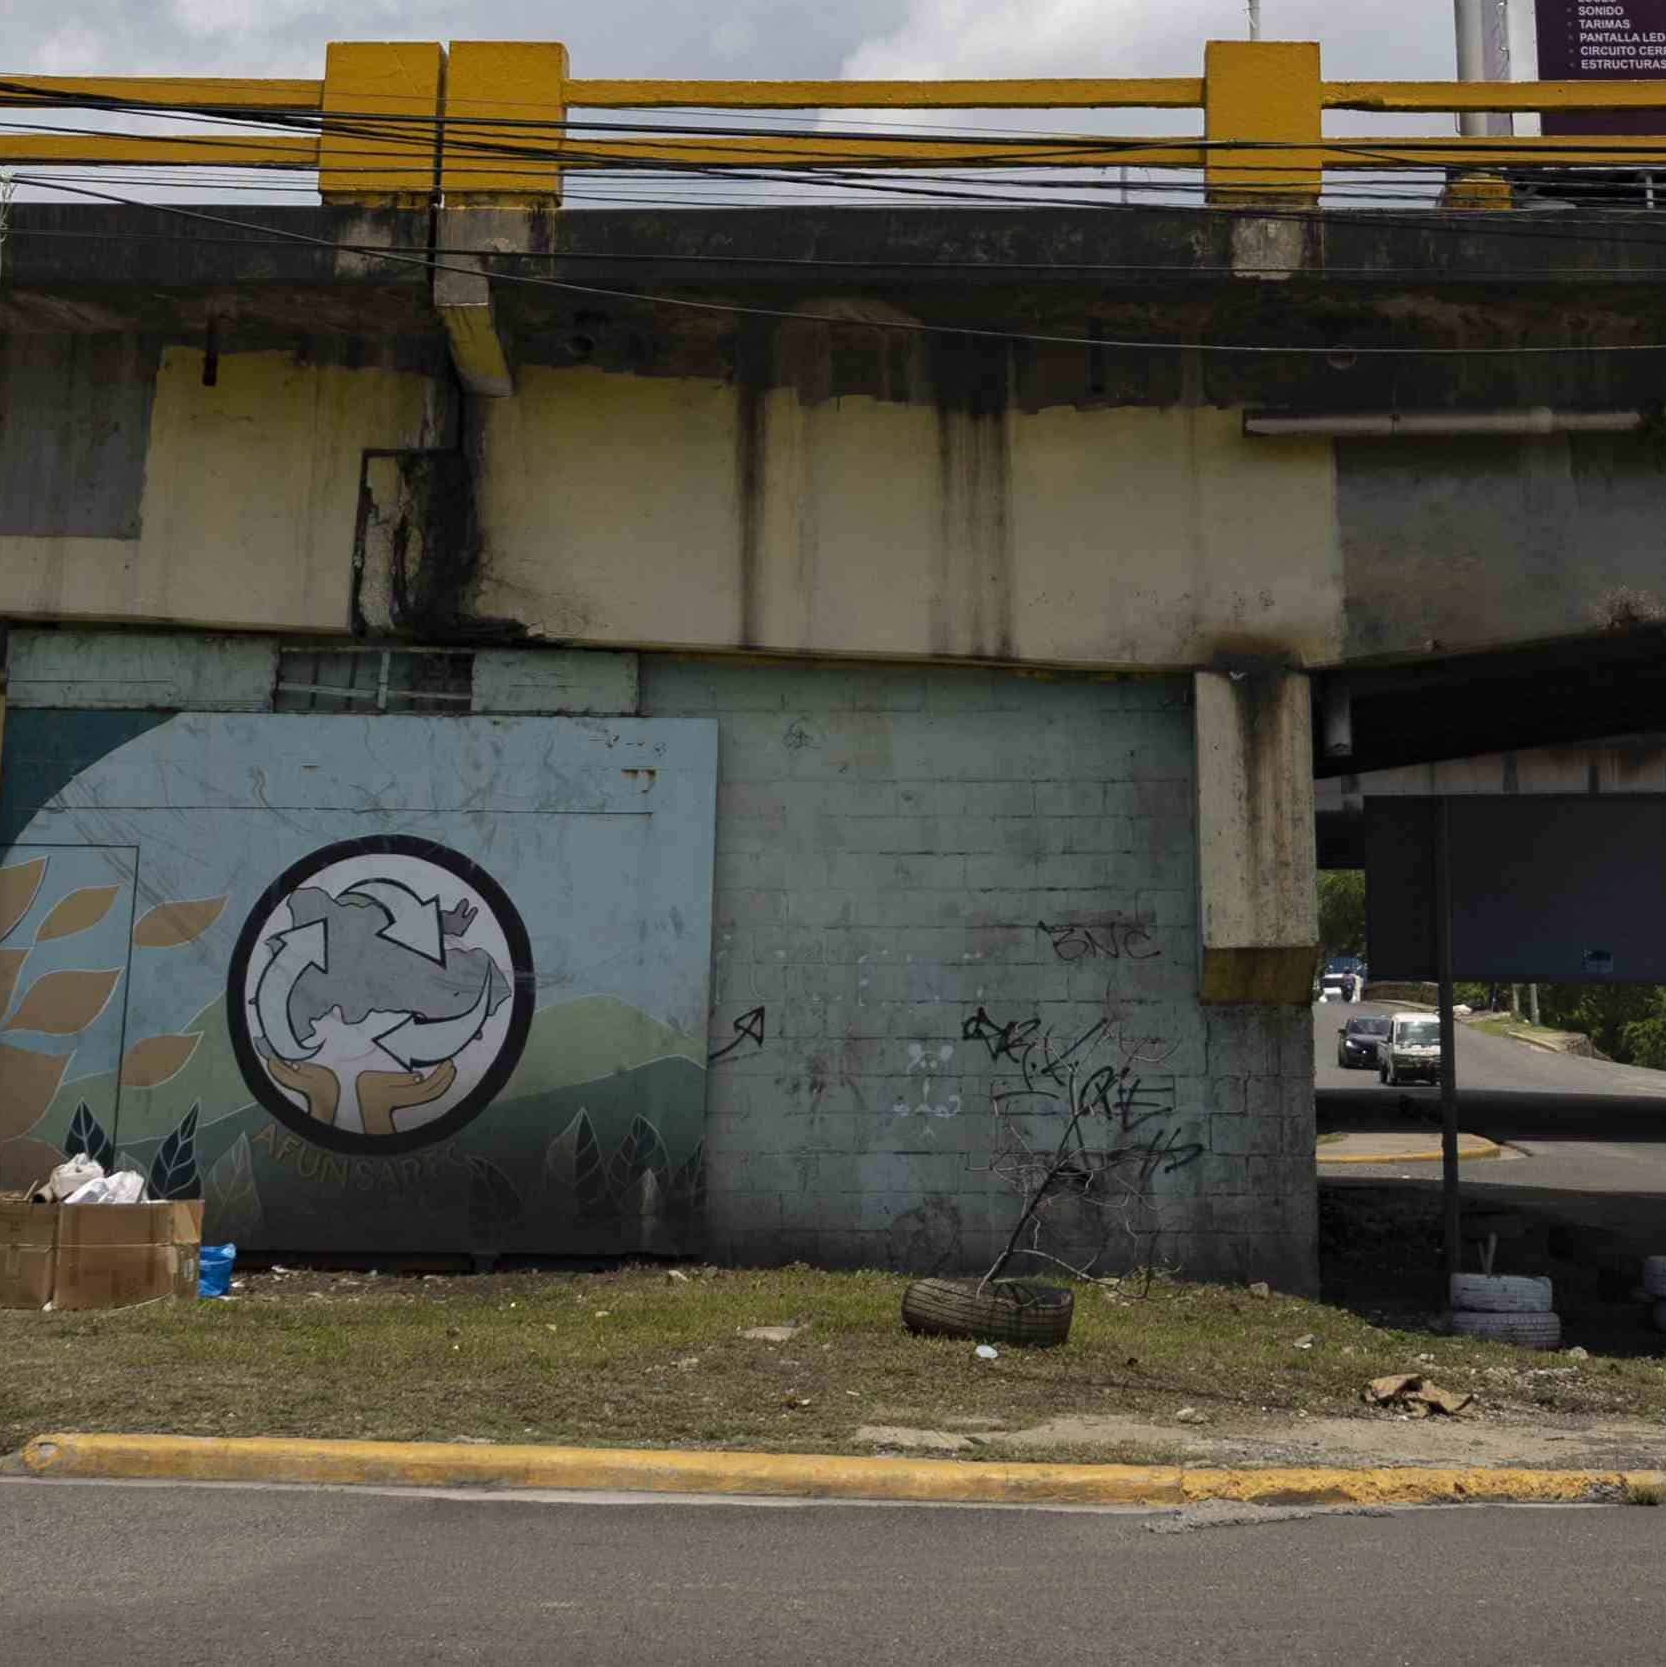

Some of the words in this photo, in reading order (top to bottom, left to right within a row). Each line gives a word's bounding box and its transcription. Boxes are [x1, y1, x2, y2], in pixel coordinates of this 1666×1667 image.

[1578, 6, 1624, 16] SONIDO
[1579, 19, 1631, 29] TARIMAS
[1580, 33, 1640, 43] PANTALLA
[1643, 33, 1666, 43] LED
[1580, 46, 1636, 56] CIRCUITO
